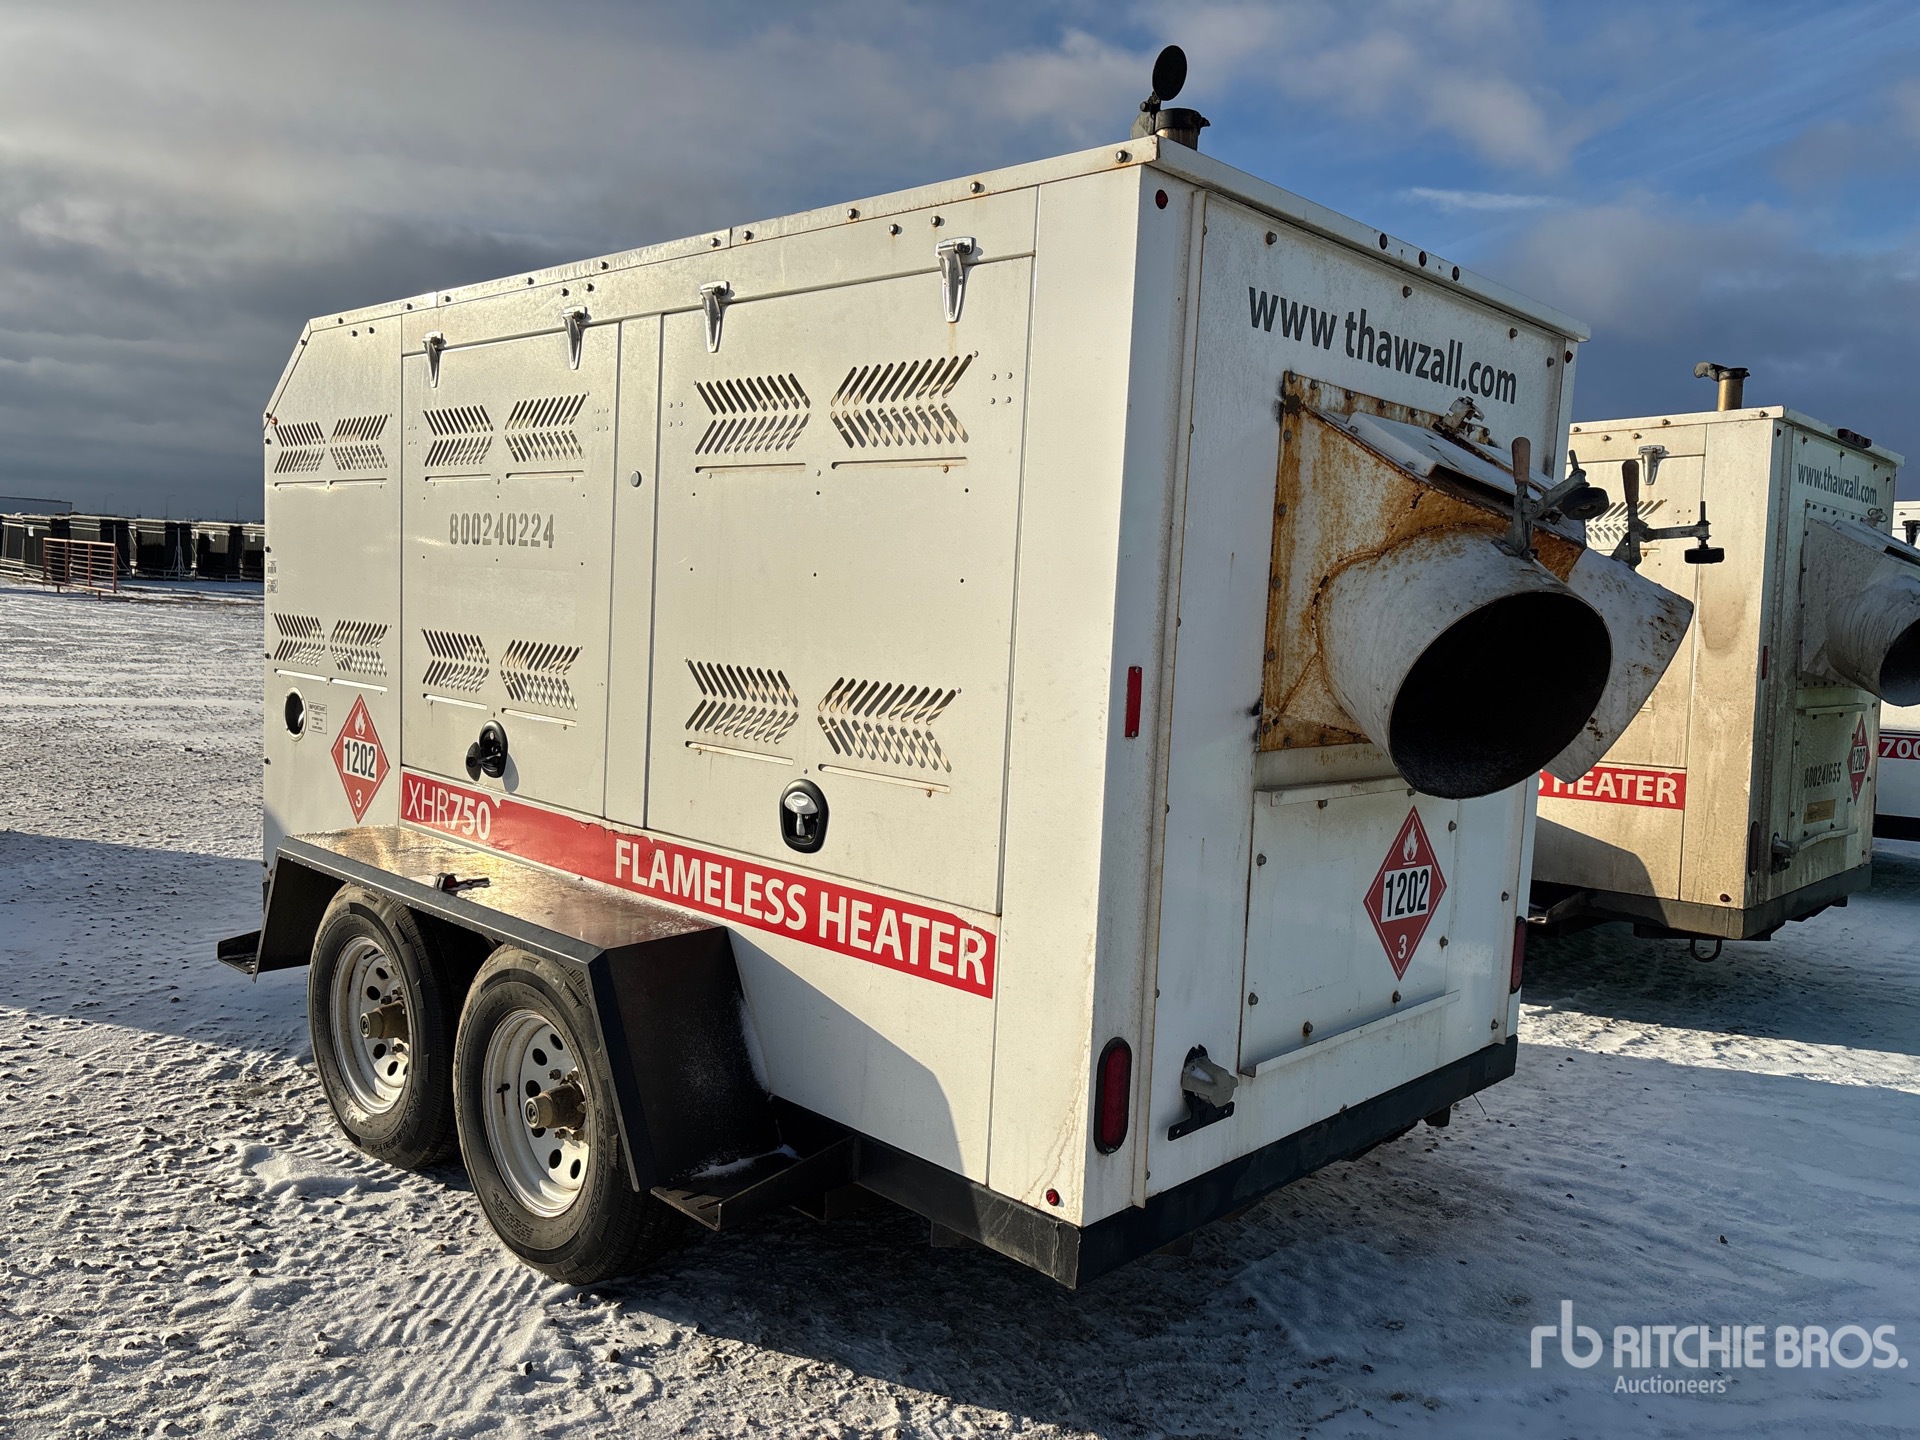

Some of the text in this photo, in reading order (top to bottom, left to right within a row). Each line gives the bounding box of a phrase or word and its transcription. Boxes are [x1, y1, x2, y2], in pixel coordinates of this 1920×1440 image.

[1344, 308, 1517, 405] thawzall.com
[1797, 463, 1877, 506] www.thawzall.com
[449, 512, 555, 548] 800240224
[344, 741, 376, 779] 1202
[355, 788, 363, 808] 3
[1552, 770, 1678, 805] HEATER
[406, 778, 491, 841] XHR750
[615, 837, 987, 986] FLAMELESS HEATER
[1385, 868, 1430, 918] 1202
[1397, 933, 1408, 960] 3
